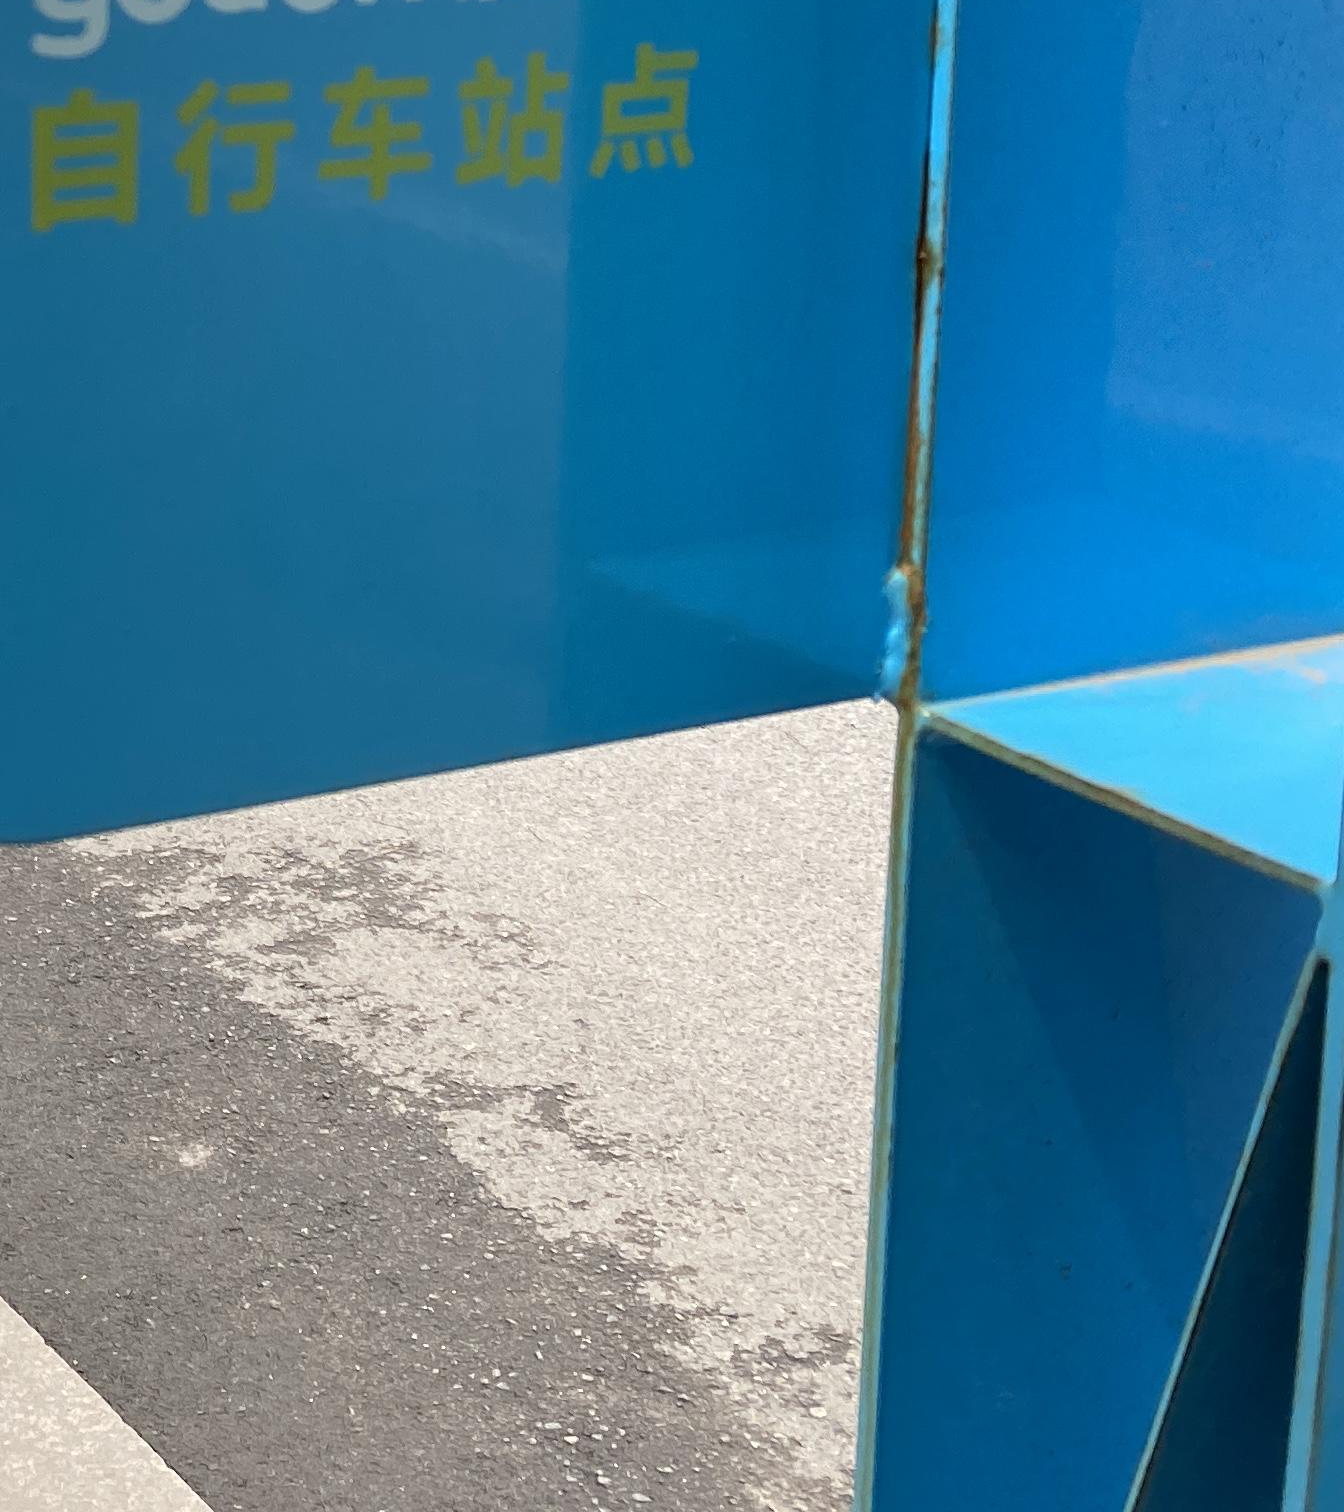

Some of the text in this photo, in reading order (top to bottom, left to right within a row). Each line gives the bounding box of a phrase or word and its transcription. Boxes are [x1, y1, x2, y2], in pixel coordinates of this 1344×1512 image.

[29, 42, 700, 233] 自行车站点
